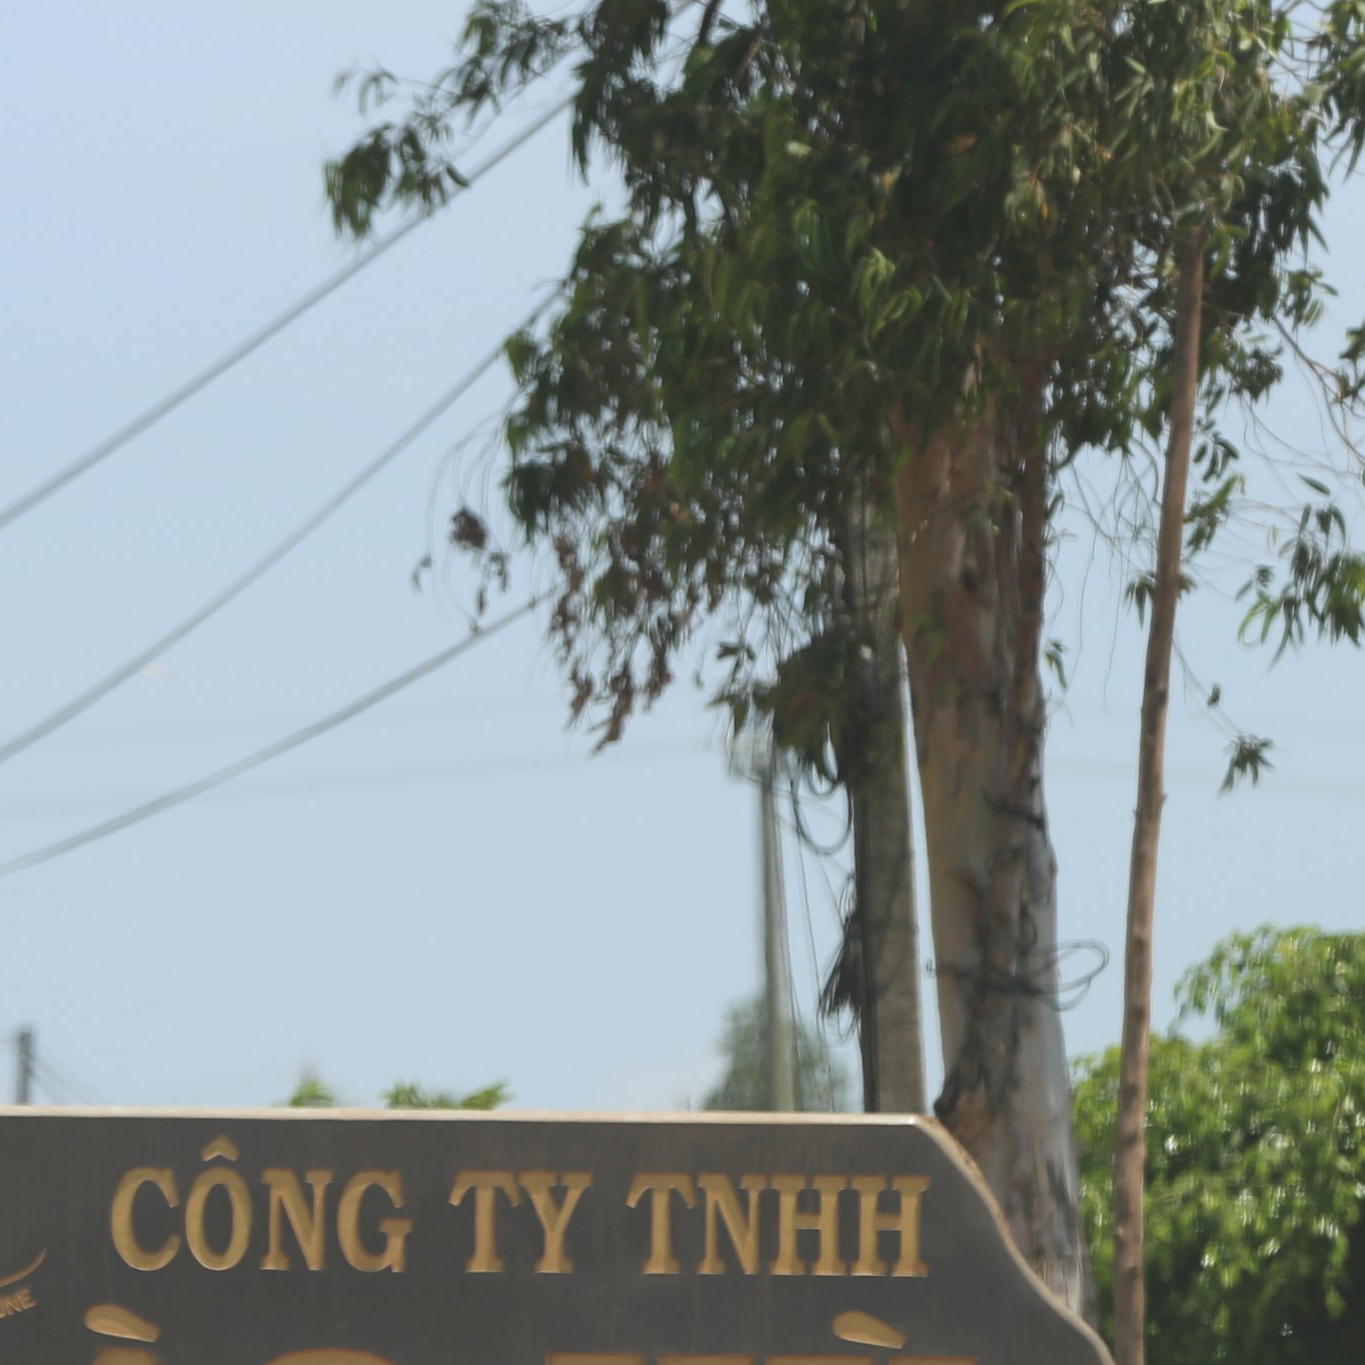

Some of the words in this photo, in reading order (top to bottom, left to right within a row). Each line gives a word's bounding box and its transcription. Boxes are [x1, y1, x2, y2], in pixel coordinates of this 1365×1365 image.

[110, 1136, 412, 1272] CÔNG
[450, 1170, 593, 1273] TY
[626, 1172, 929, 1278] TNHH
